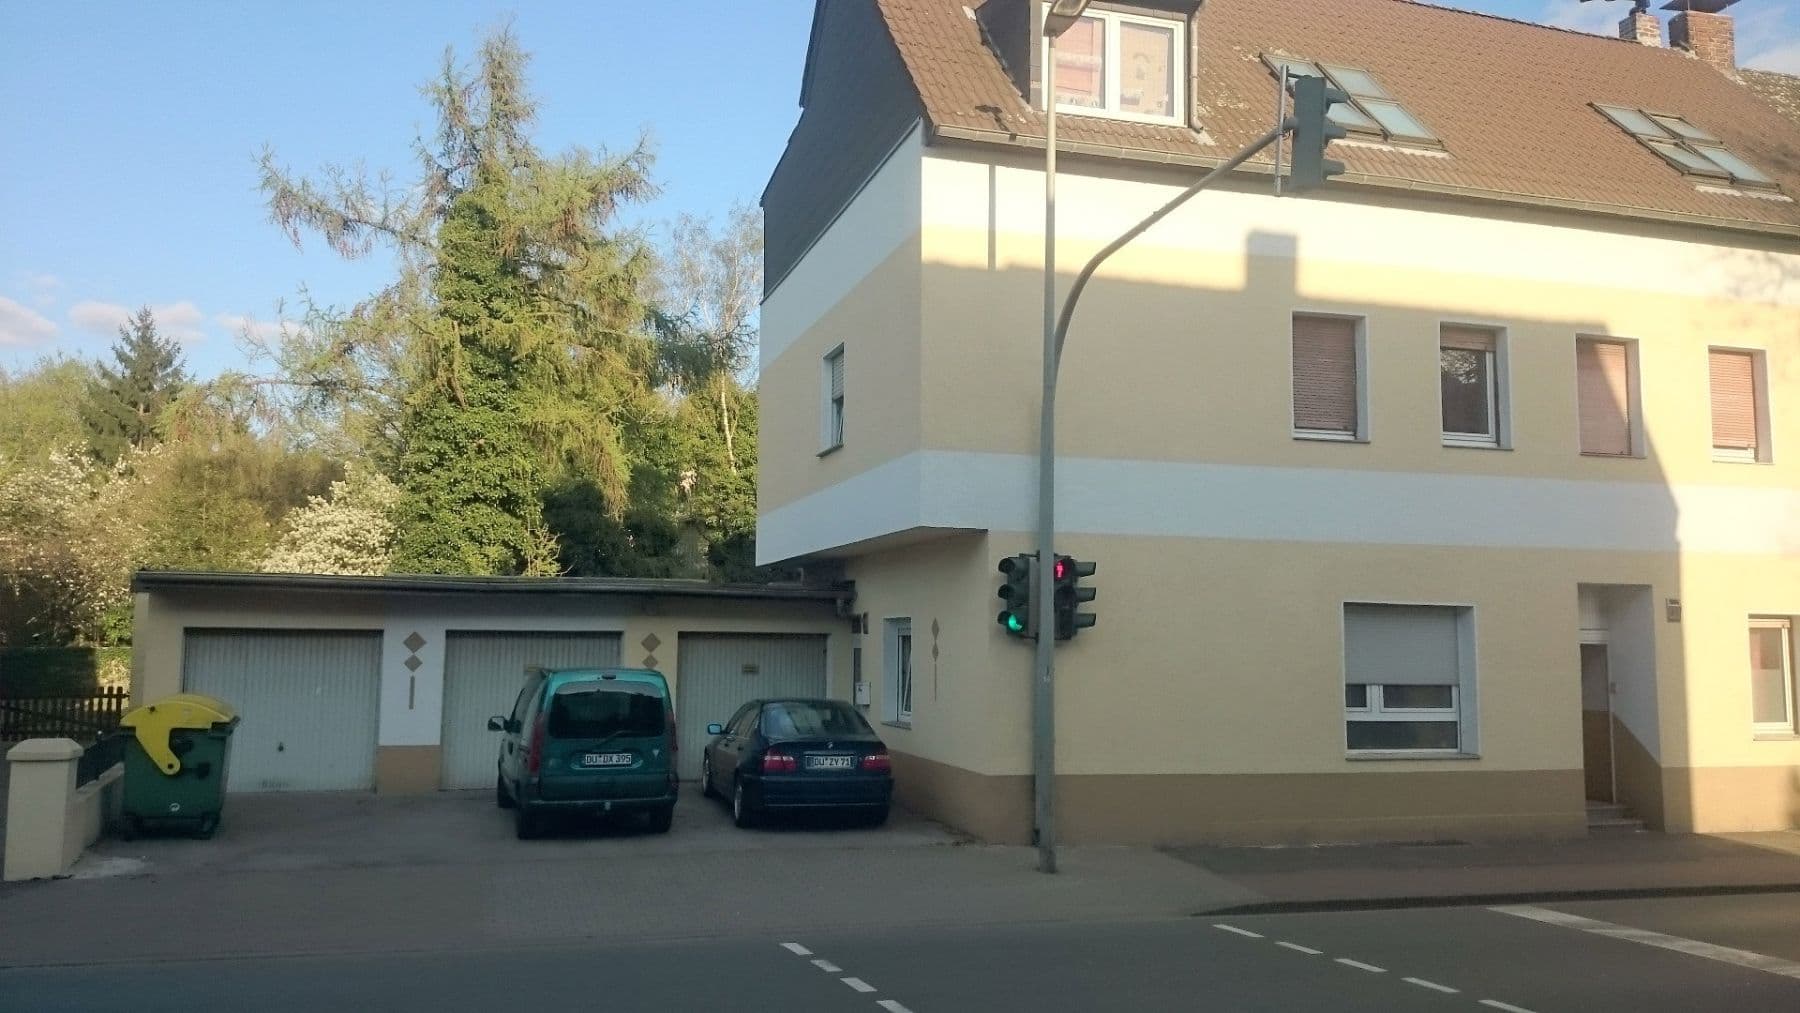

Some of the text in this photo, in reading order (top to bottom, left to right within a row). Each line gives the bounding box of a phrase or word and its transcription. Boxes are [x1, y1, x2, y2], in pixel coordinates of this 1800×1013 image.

[586, 755, 598, 764] DU
[615, 754, 631, 763] 395
[814, 757, 825, 766] DU
[829, 757, 839, 766] ZY
